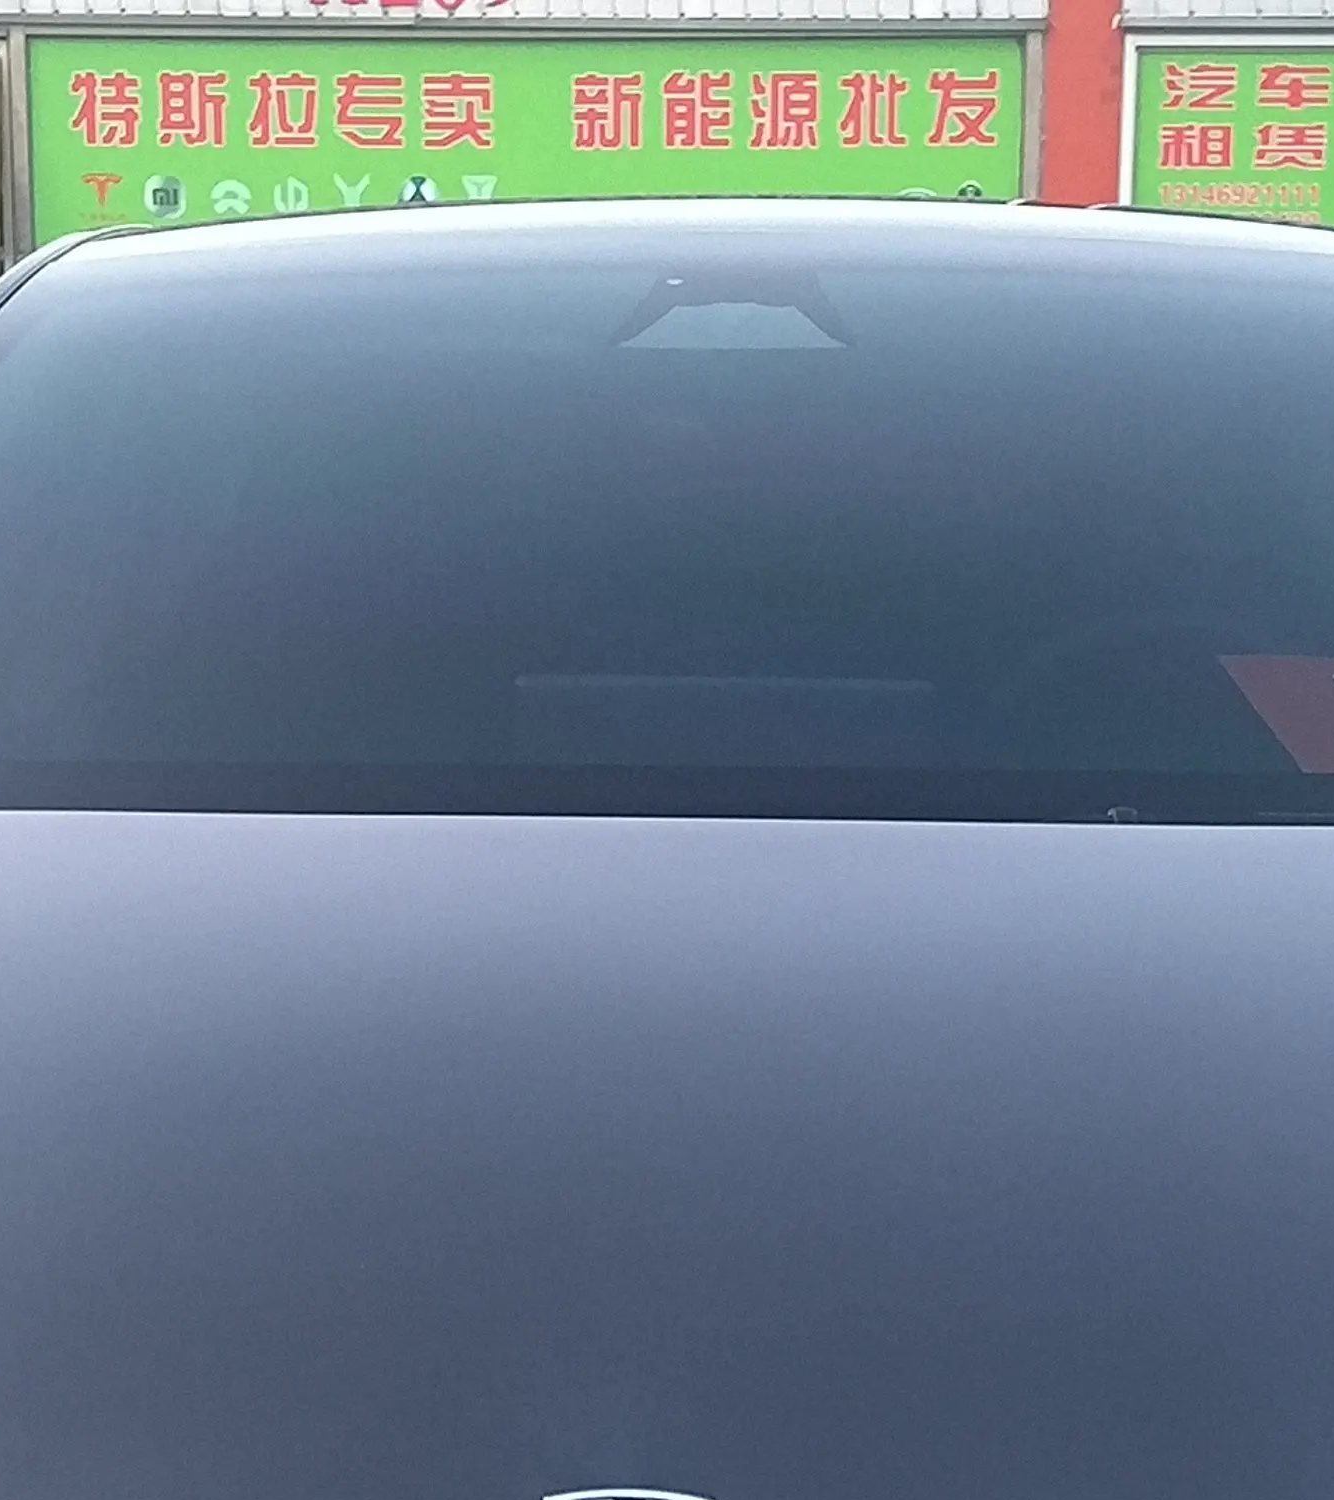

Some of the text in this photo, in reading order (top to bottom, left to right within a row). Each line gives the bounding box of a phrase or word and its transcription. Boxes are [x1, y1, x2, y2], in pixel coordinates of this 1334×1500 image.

[70, 69, 1001, 150] 特斯拉专卖 新能源批发
[1160, 62, 1333, 110] 汽车
[1158, 122, 1327, 170] 租赁
